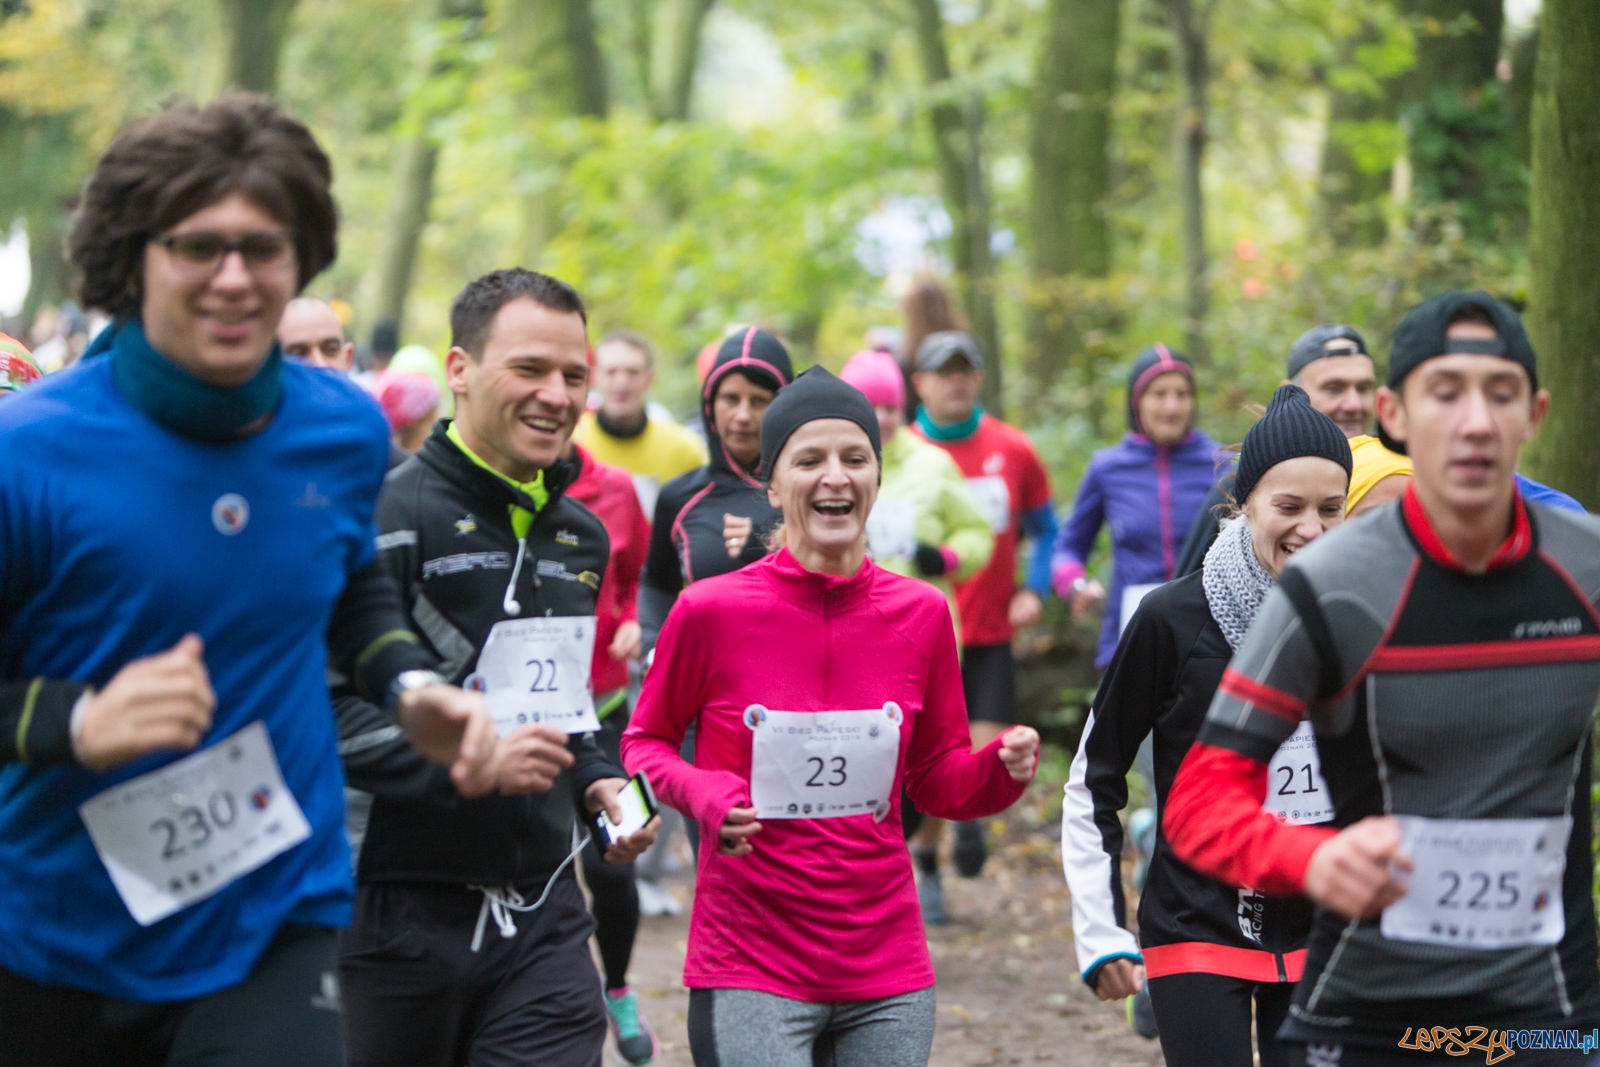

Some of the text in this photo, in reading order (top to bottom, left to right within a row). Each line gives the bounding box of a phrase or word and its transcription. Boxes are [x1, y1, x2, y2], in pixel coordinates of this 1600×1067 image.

[525, 659, 559, 692] 22
[805, 756, 848, 787] 23
[1277, 763, 1318, 796] 21
[150, 790, 239, 861] 230
[1438, 870, 1521, 909] 225
